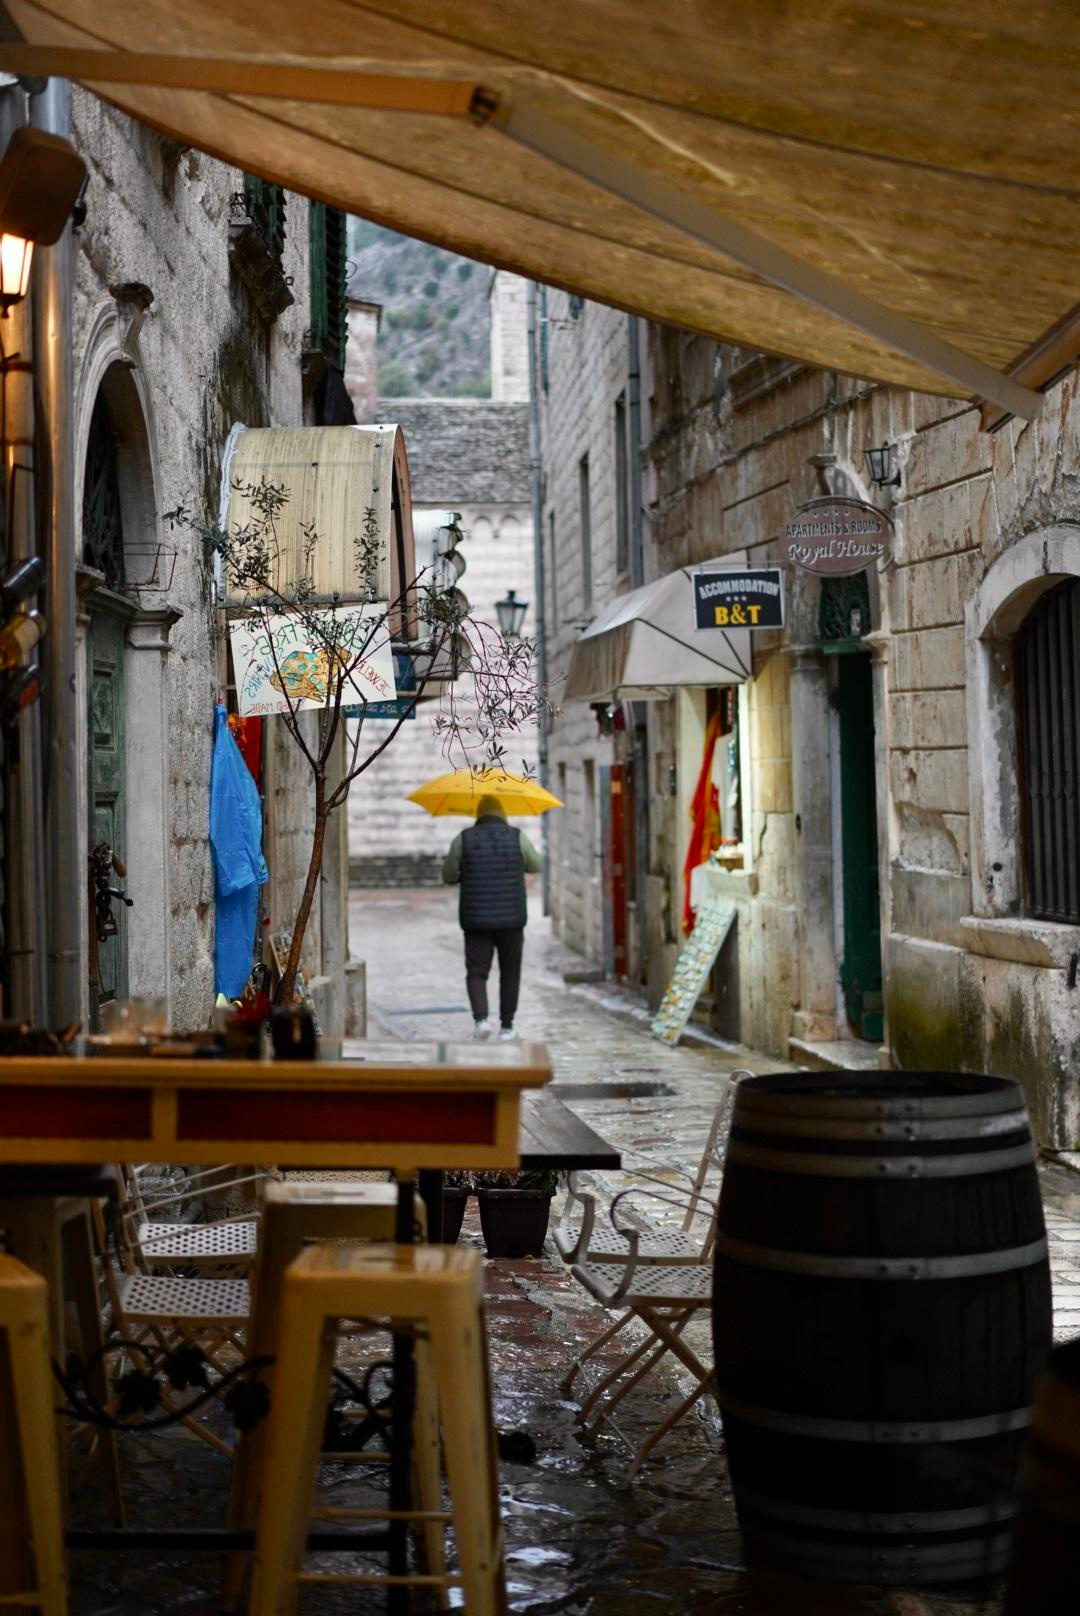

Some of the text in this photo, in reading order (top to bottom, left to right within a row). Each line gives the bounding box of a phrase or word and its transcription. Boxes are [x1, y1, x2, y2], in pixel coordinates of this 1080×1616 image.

[786, 522, 840, 538] APARTMENTS
[851, 519, 882, 534] ROOMS
[788, 540, 884, 564] Royal House
[698, 579, 780, 600] ACCOMMODATION
[714, 603, 762, 625] B&T
